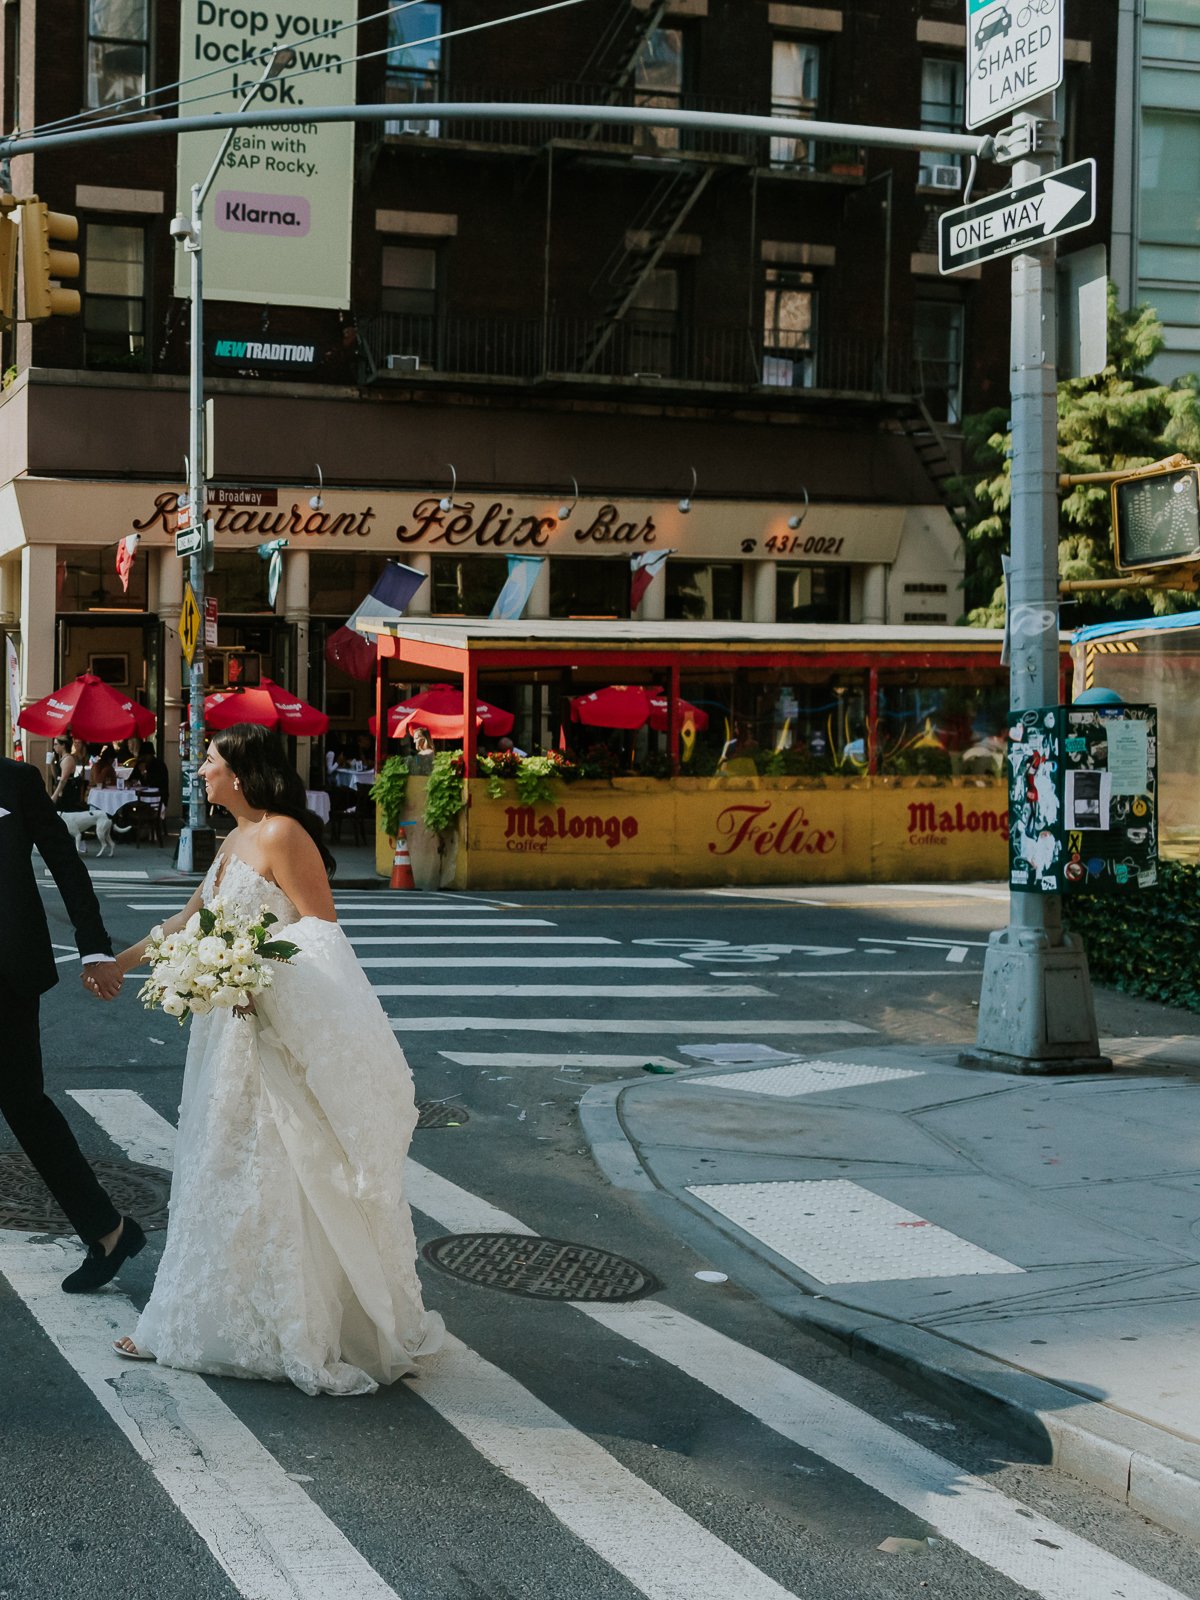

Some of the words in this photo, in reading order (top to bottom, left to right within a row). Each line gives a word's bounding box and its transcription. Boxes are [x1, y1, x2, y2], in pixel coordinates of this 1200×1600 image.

[197, 0, 269, 36] Drop
[275, 13, 343, 39] your
[978, 25, 1051, 80] SHARED
[232, 73, 304, 105] look.
[989, 61, 1037, 104] LANE
[230, 134, 266, 151] gain
[271, 137, 306, 153] with
[265, 156, 318, 177] Rocky.
[225, 202, 300, 226] Klarna.
[956, 216, 994, 249] ONE
[1002, 198, 1043, 232] WAY
[215, 340, 314, 363] NEWTRADITION
[208, 490, 215, 501] W
[219, 490, 262, 505] Broadway
[132, 491, 377, 536] Rtaurant
[396, 498, 557, 547] Félix
[574, 504, 657, 543] Bar
[764, 535, 844, 555] 431-0021
[504, 806, 639, 848] Malongo
[708, 801, 836, 855] Félix
[907, 801, 1009, 841] Malong
[506, 839, 548, 852] Coffee
[909, 834, 949, 846] Coffee
